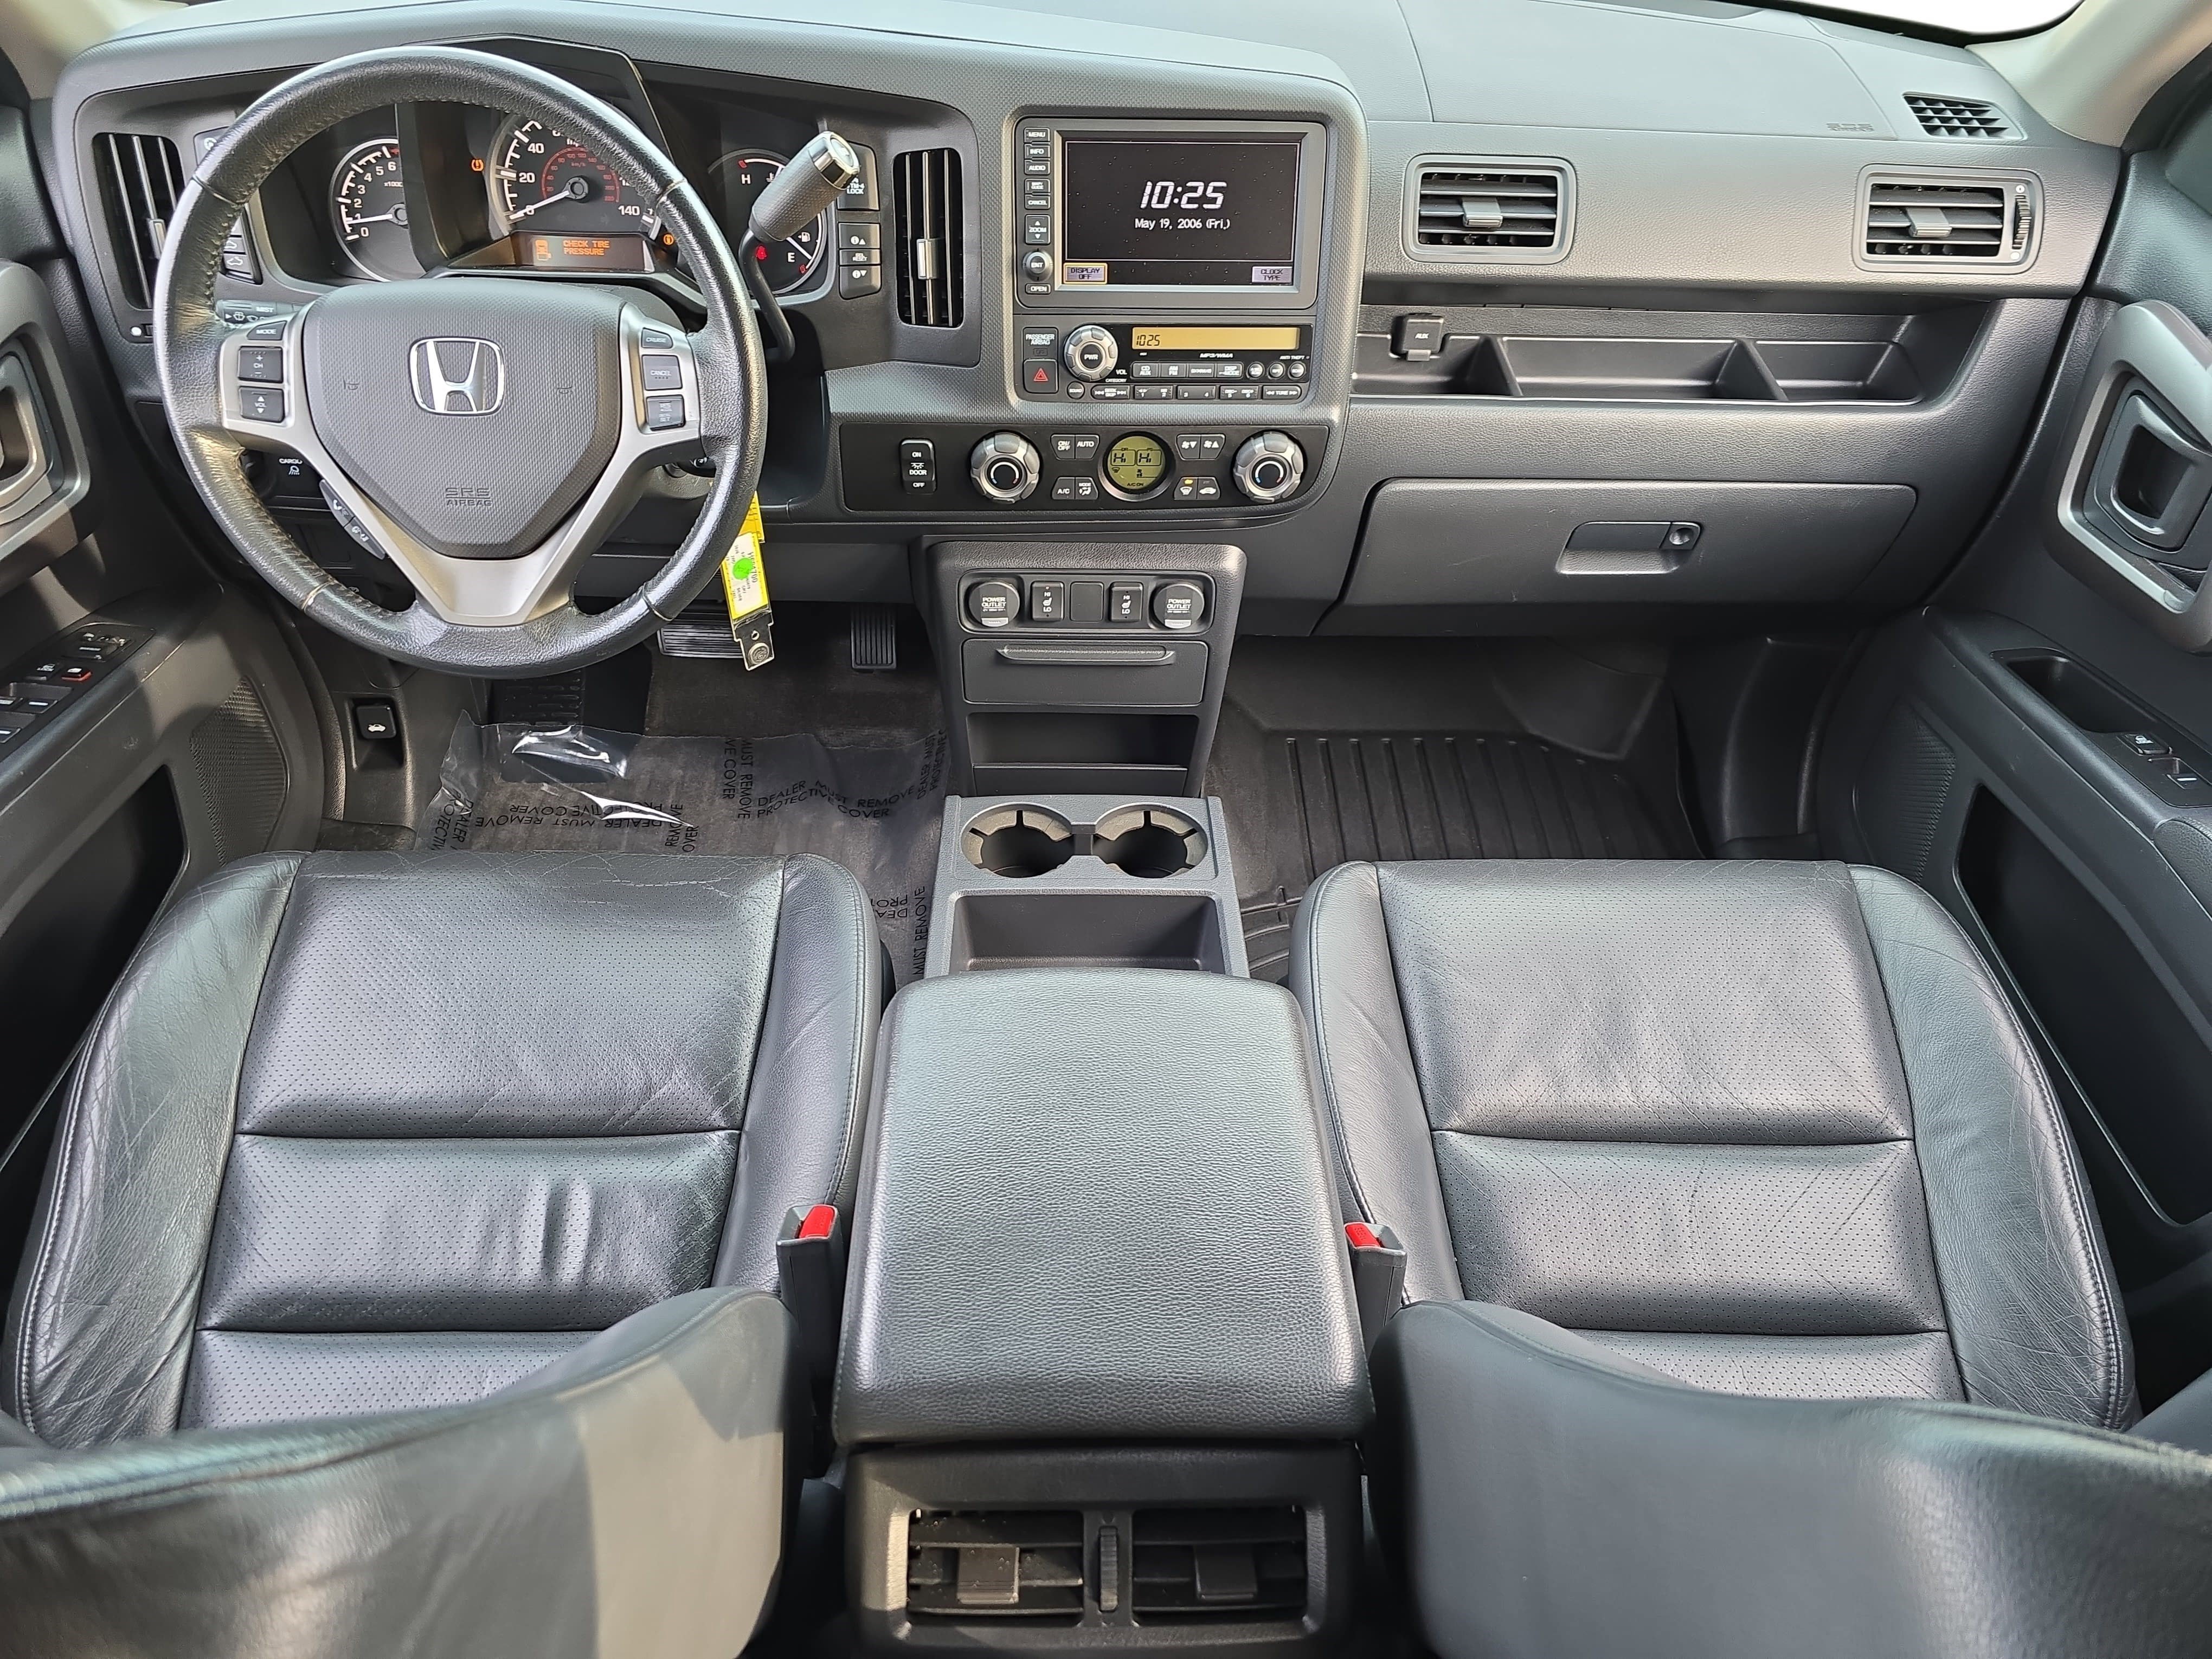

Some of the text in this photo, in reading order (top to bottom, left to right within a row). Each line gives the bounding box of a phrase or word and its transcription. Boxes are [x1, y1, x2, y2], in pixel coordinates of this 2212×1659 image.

[528, 143, 544, 153] 40
[376, 166, 384, 175] 5
[388, 162, 396, 171] 6
[364, 173, 372, 182] 4
[519, 172, 535, 183] 20
[741, 174, 751, 184] H
[357, 185, 365, 194] 3
[1140, 181, 1227, 209] 10:25
[353, 198, 362, 208] 2
[618, 205, 640, 216] 140
[1135, 218, 1231, 230] May 19, 2006 (Fri.)
[361, 227, 369, 237] 0
[788, 253, 795, 262] E
[446, 487, 490, 497] SRS
[722, 759, 736, 799] COVER
[737, 774, 753, 819] REMOVE
[758, 779, 914, 808] DEALER MUST REMOVE
[757, 788, 890, 819] PROTECTIVE COVER
[510, 804, 567, 816] COVER
[475, 815, 662, 828] DEALER MUST REMOVE
[665, 804, 683, 847] REMOVE
[912, 886, 929, 975] MUST REMOVE
